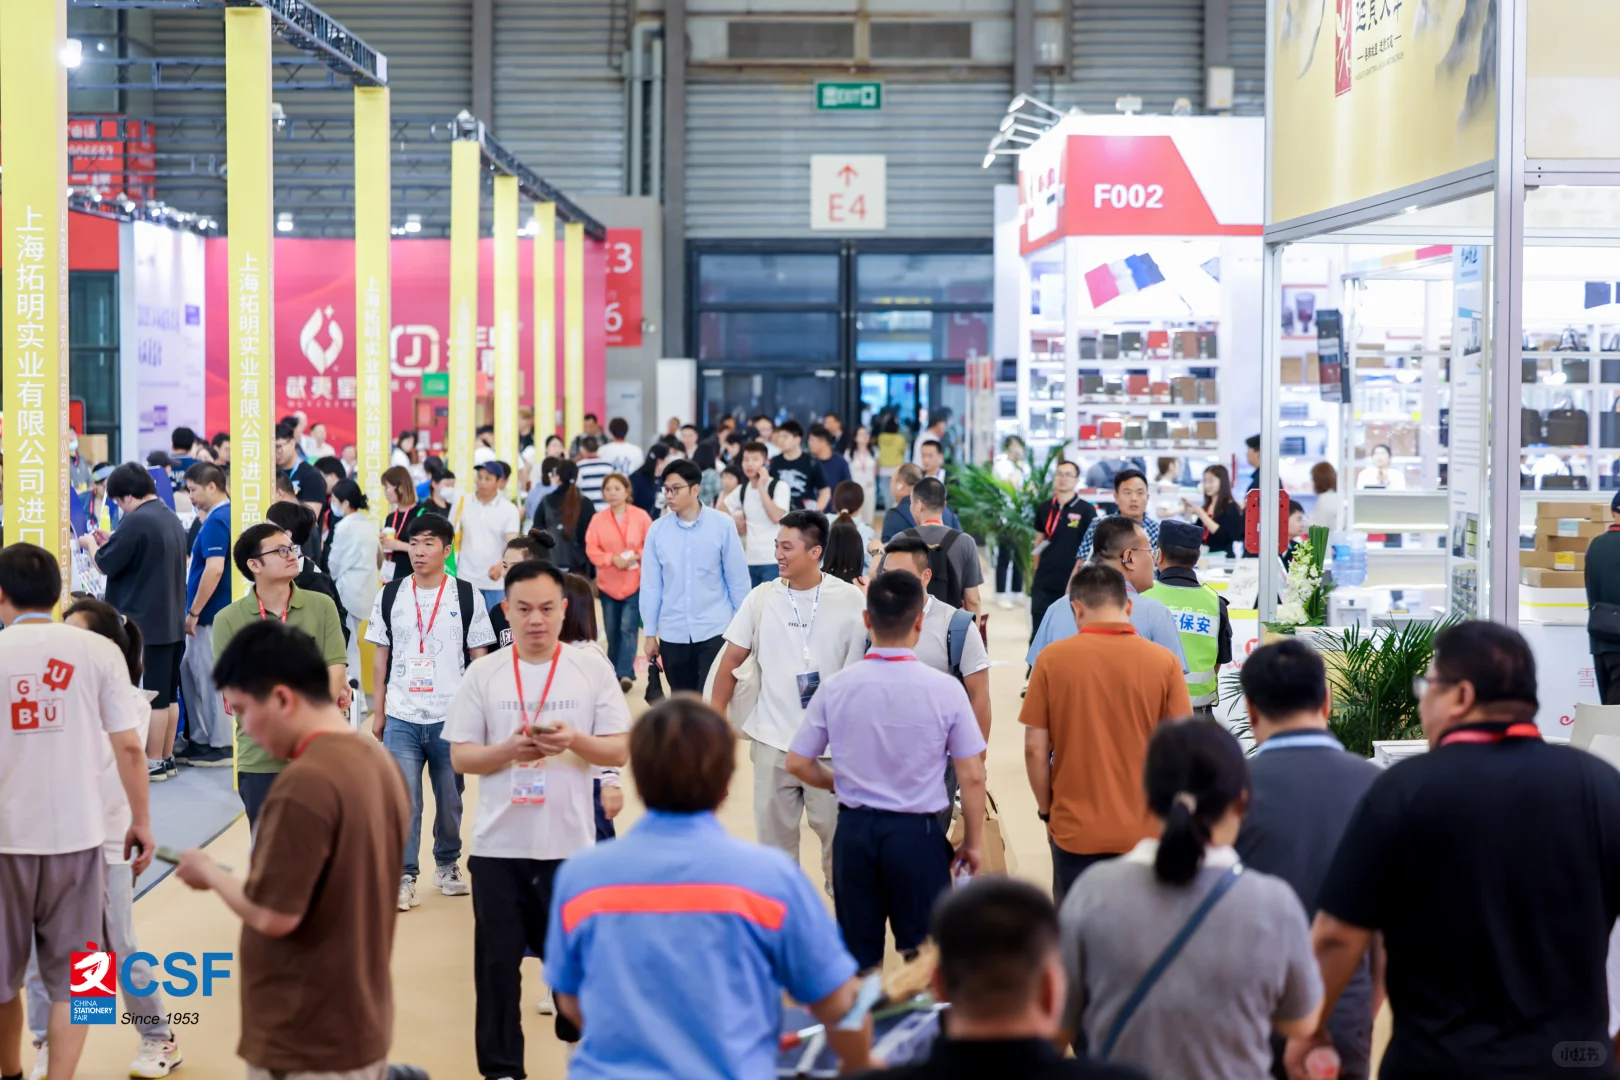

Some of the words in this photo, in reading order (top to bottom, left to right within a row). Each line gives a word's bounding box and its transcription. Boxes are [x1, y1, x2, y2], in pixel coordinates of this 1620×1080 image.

[829, 193, 868, 222] E4
[1094, 183, 1164, 209] F002
[17, 680, 30, 695] G
[50, 665, 68, 683] U
[18, 708, 33, 725] B
[44, 706, 56, 722] U
